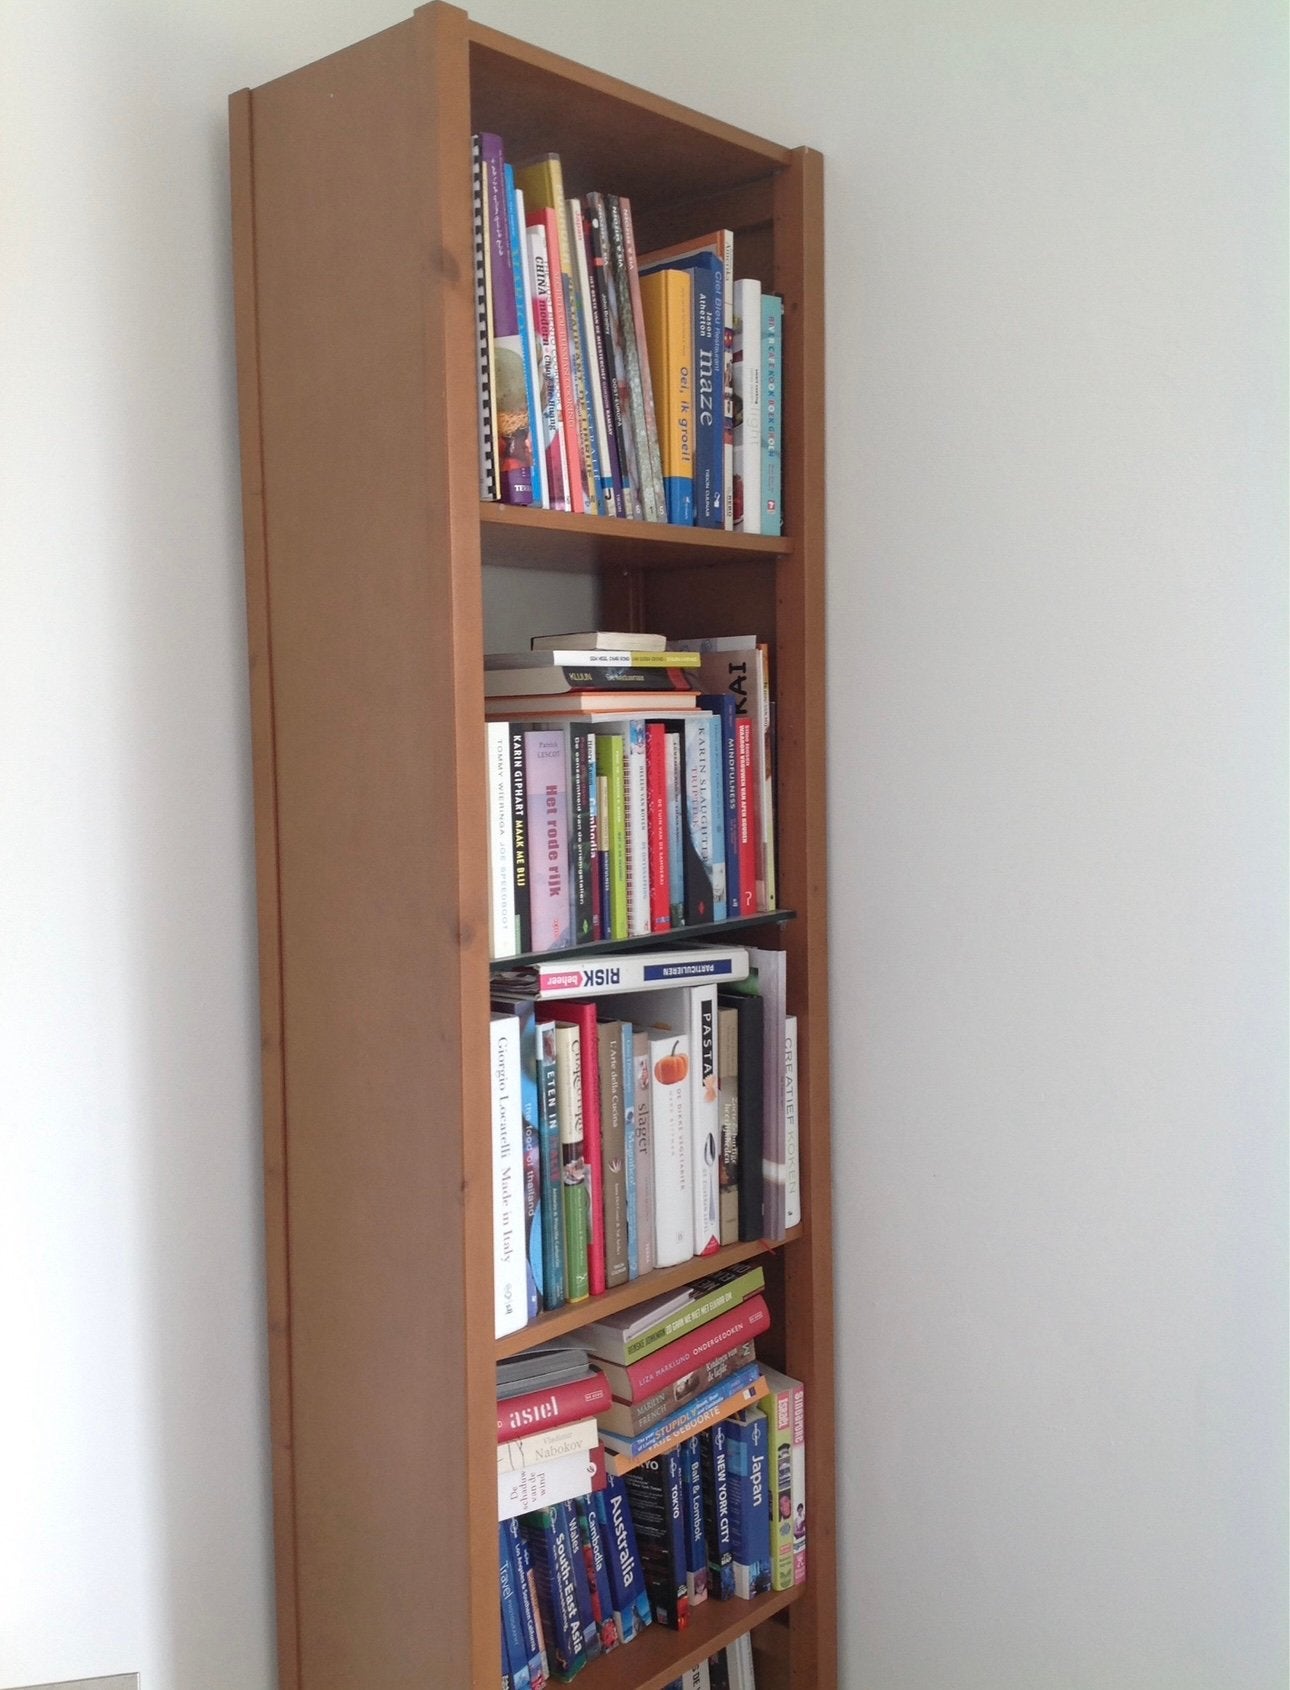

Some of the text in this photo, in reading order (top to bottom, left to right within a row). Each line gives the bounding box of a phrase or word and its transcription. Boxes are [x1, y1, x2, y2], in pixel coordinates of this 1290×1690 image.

[535, 257, 548, 296] CHINA
[540, 300, 552, 347] modern
[699, 293, 709, 337] Atherton
[705, 311, 714, 338] Jason
[713, 270, 723, 372] Ciel Bleu Restaurant
[767, 316, 776, 344] RIVER
[596, 336, 606, 381] MEESTERCHEF
[604, 410, 614, 436] RAMSAY
[680, 367, 690, 394] Oei,
[699, 348, 714, 426] maze
[767, 370, 776, 397] KOOK
[611, 378, 624, 428] OOST-EUROPA
[681, 400, 691, 413] ik
[768, 399, 776, 424] BOEK
[679, 418, 691, 462] groei!
[512, 735, 524, 767] KARIN
[574, 736, 581, 749] De
[728, 737, 737, 810] MINDFULNESS
[514, 770, 525, 816] GIPHART
[657, 798, 663, 808] DE
[698, 727, 710, 865] KARIN SLAUGHTER
[740, 786, 748, 802] VAN
[515, 820, 526, 848] MAAK
[640, 808, 648, 831] ROYEN
[545, 785, 562, 897] Het rode rijk
[577, 831, 584, 843] de
[658, 841, 664, 851] DE
[517, 850, 526, 864] ME
[577, 844, 587, 905] priemgetallen
[500, 866, 509, 929] SPEEDBOOT
[546, 974, 580, 988] beheer
[584, 967, 621, 988] RISK
[662, 964, 716, 978] PARTICULIEREN
[702, 1012, 713, 1074] PASTA
[547, 1070, 556, 1107] ETEN
[676, 1087, 683, 1100] DE
[549, 1113, 558, 1130] IN
[611, 1094, 620, 1128] Cucina
[784, 1037, 797, 1195] CREATIEF KOKEN
[636, 1103, 650, 1154] slager
[722, 1102, 734, 1164] heerlijkheden
[496, 1037, 514, 1263] Giorgio Locatelli Made in Italy
[525, 1102, 537, 1217] the food of thailand
[639, 1375, 655, 1388] LIZA
[656, 1353, 691, 1378] MARKLUND
[692, 1322, 744, 1356] ONDERGEDOKEN
[639, 1404, 668, 1428] FRENCH
[655, 1403, 698, 1440] STUPIDLY
[534, 1438, 584, 1462] Nabokov
[691, 1461, 701, 1485] Bali
[716, 1453, 726, 1482] NEW
[750, 1455, 765, 1507] Japan
[510, 1487, 519, 1500] De
[530, 1485, 538, 1503] van
[537, 1472, 547, 1497] wind
[692, 1486, 701, 1495] &
[718, 1483, 729, 1516] YORK
[670, 1484, 681, 1519] TOKYO
[568, 1517, 582, 1554] Wales
[692, 1496, 704, 1542] Lombok
[720, 1517, 731, 1544] CITY
[515, 1543, 523, 1557] Los
[587, 1510, 604, 1572] Cambodia
[609, 1494, 636, 1588] Australia
[499, 1560, 514, 1601] Travel
[516, 1556, 527, 1583] Angeles
[521, 1588, 533, 1620] Southern
[555, 1532, 579, 1619] South-East
[570, 1619, 583, 1655] Asia
[526, 1619, 537, 1652] California
